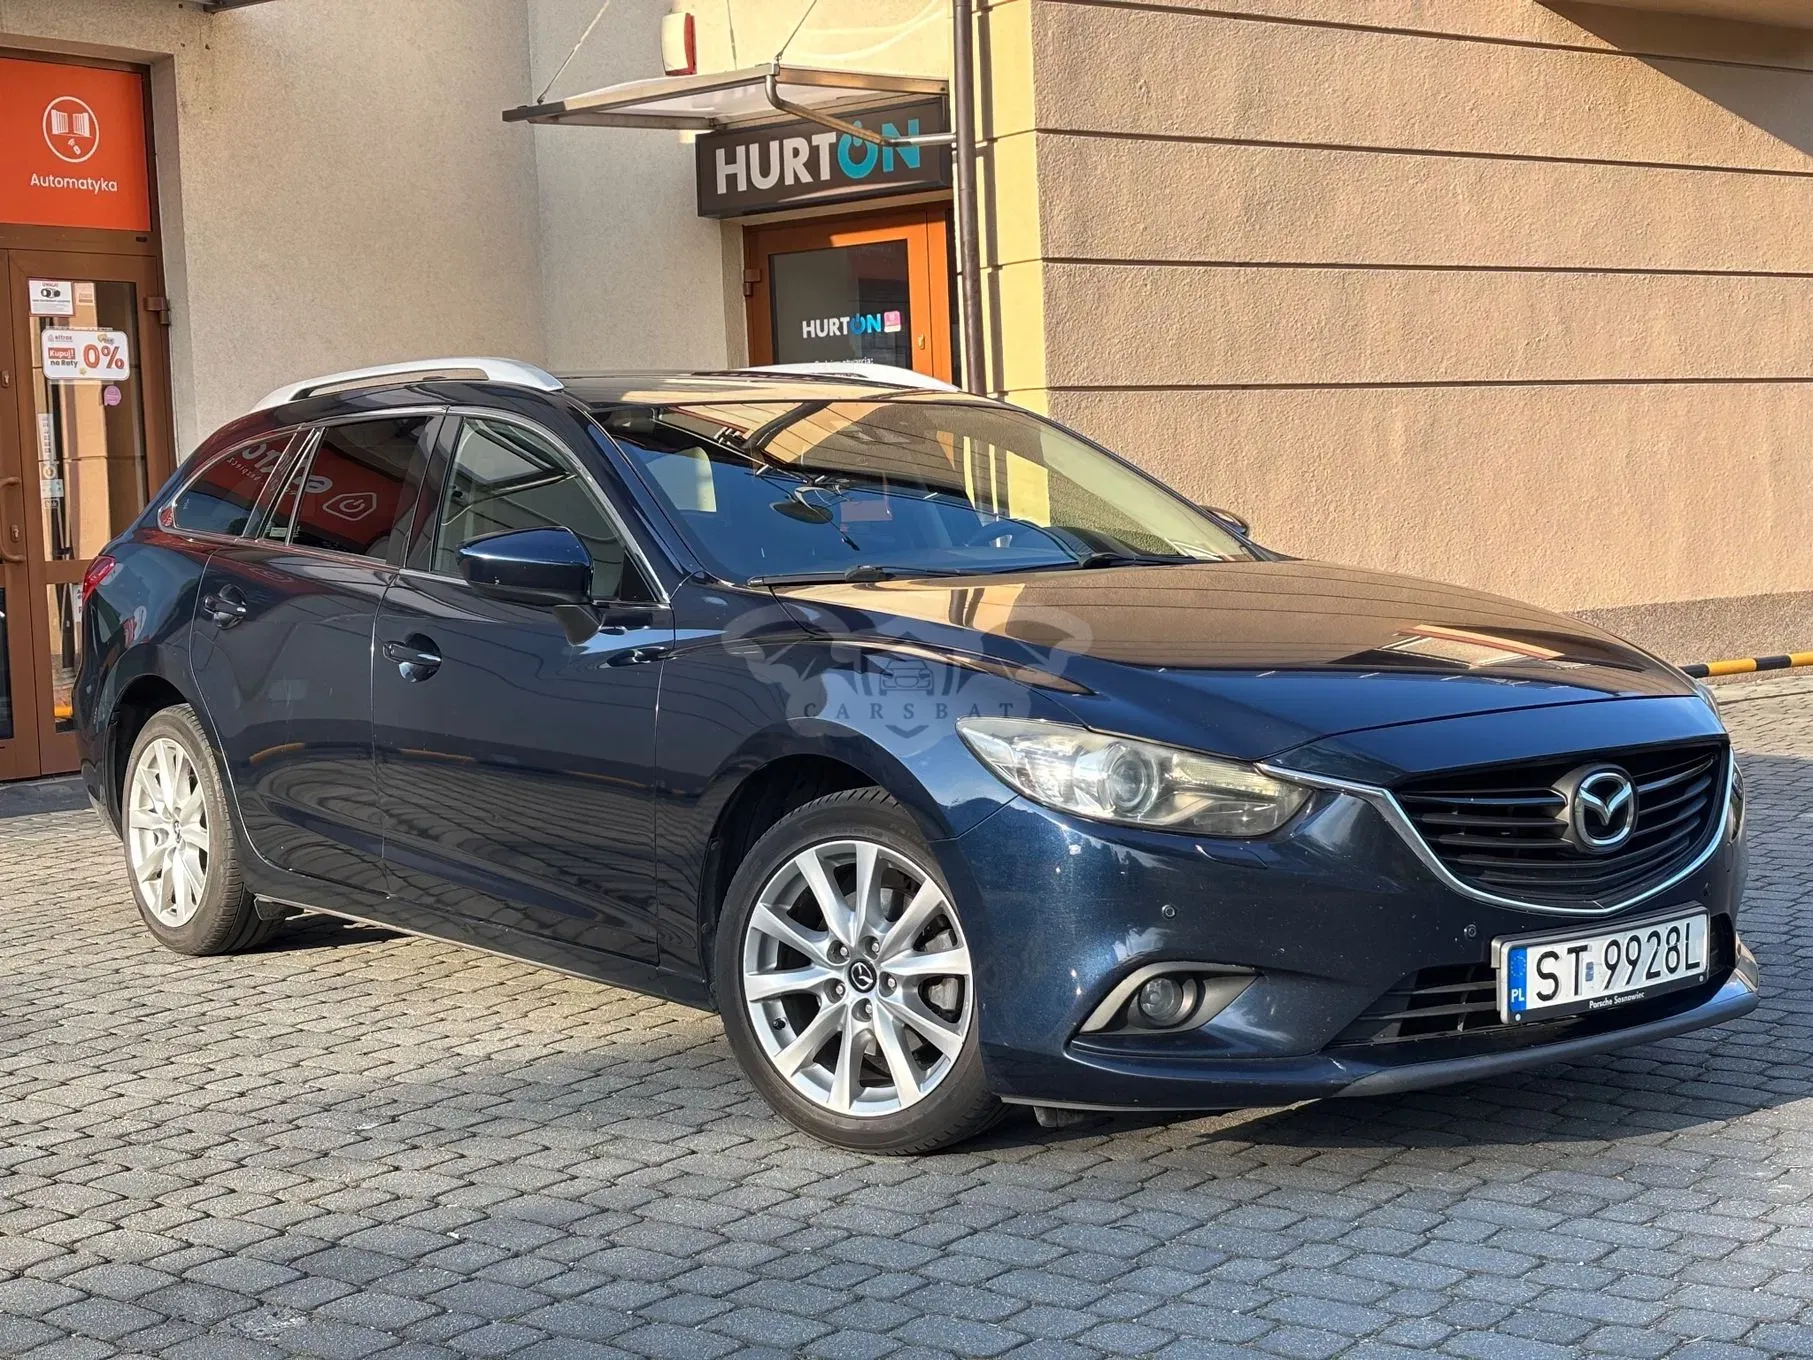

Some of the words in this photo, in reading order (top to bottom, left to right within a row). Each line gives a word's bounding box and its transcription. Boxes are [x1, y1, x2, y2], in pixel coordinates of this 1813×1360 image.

[715, 118, 921, 195] HURTON
[30, 173, 118, 195] Automatyka
[801, 312, 882, 339] HURTON
[49, 348, 74, 359] Kupuj!
[61, 360, 78, 368] Raty
[83, 344, 124, 369] 0%
[1536, 945, 1588, 1001] ST
[1603, 923, 1700, 990] 9928L
[1511, 988, 1525, 1003] PL
[1589, 997, 1613, 1009] Porsche
[1613, 991, 1645, 1005] Sosnowiec
